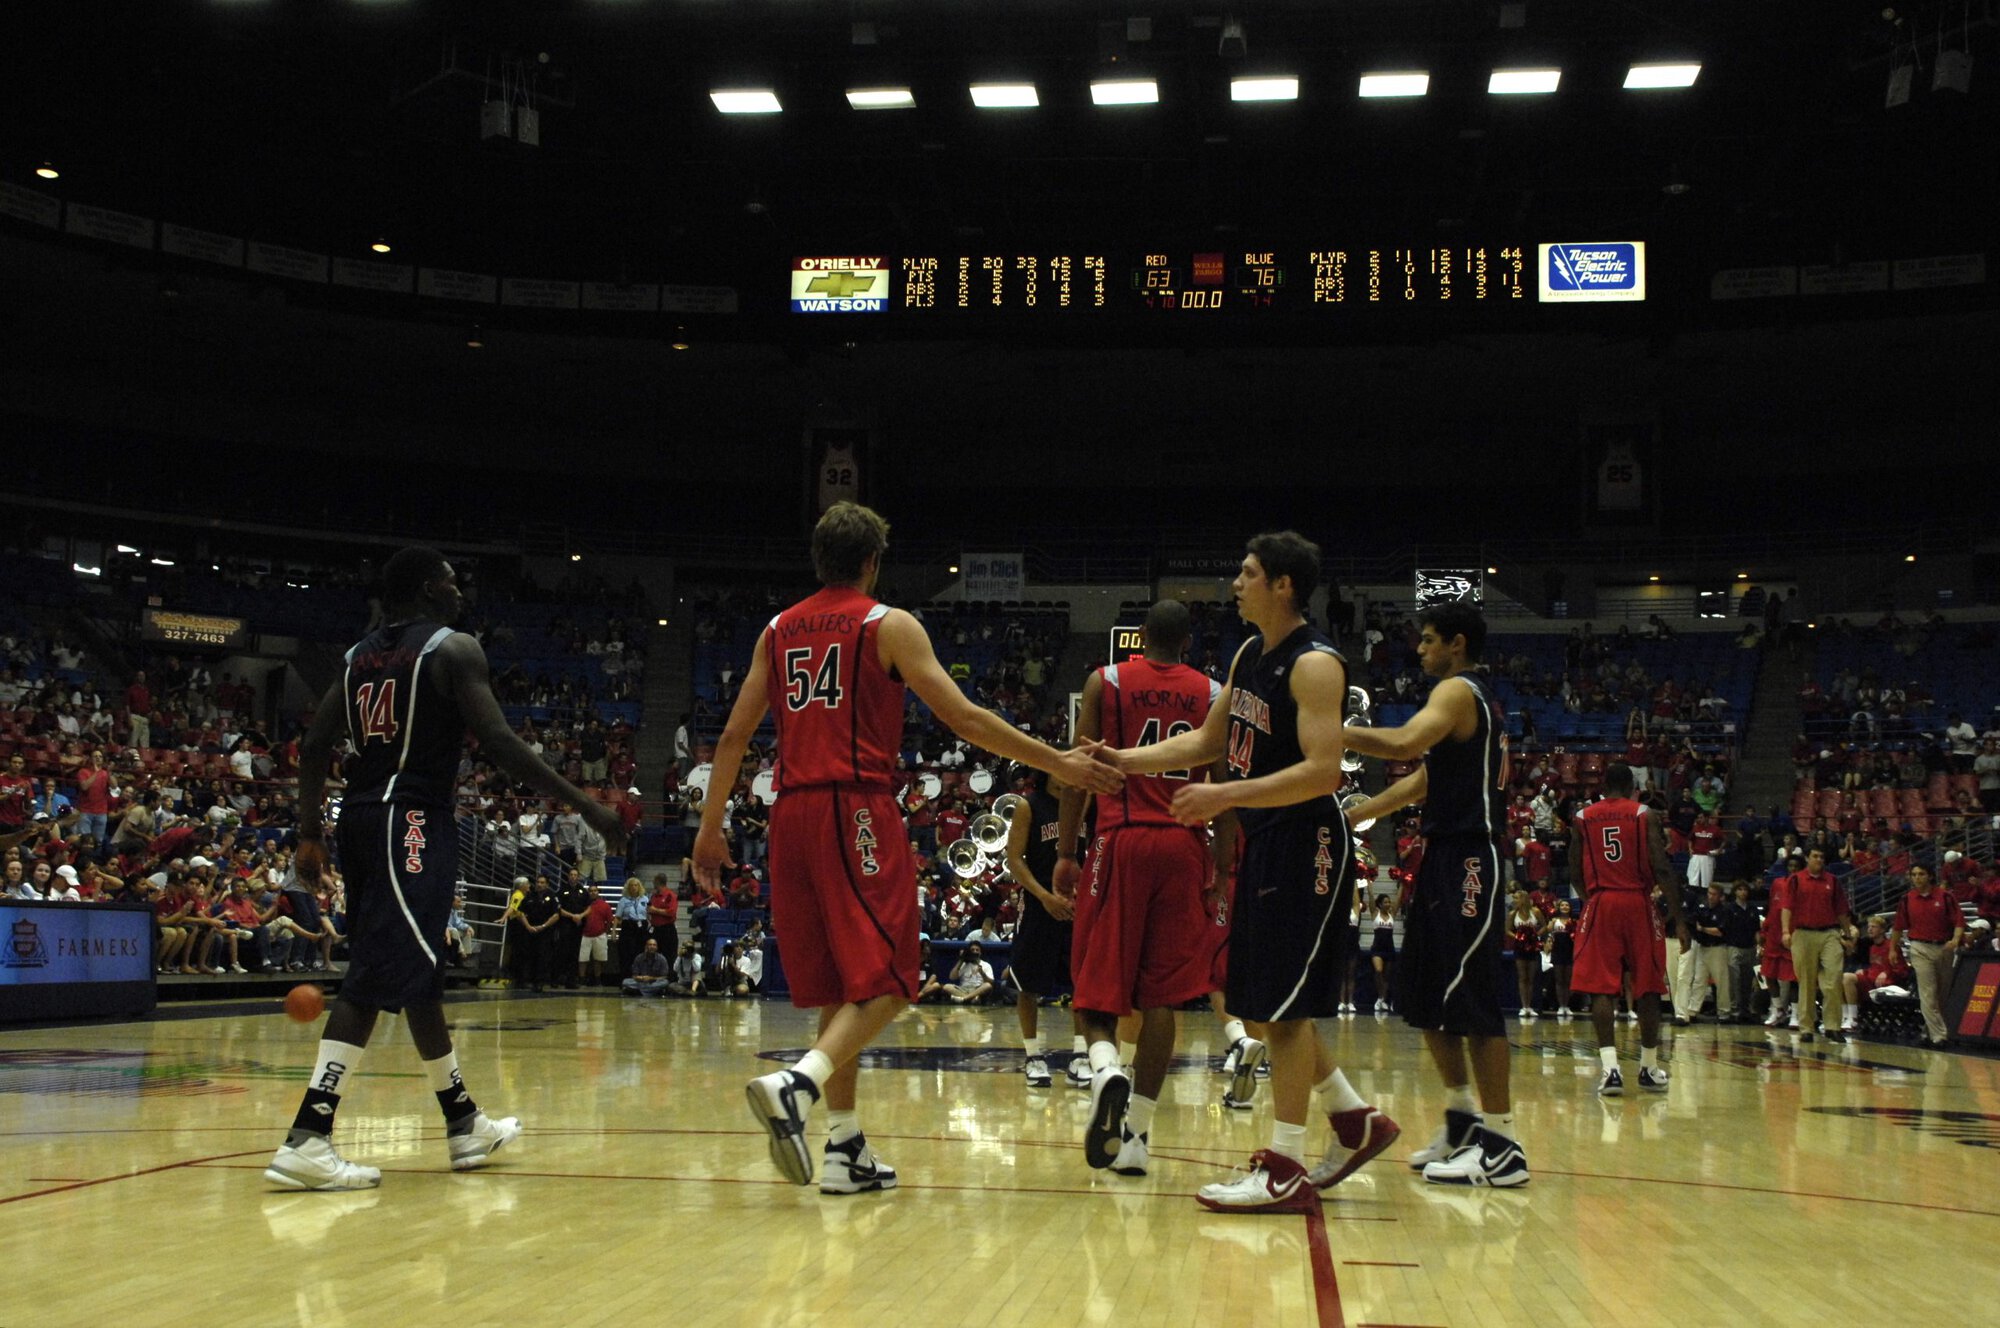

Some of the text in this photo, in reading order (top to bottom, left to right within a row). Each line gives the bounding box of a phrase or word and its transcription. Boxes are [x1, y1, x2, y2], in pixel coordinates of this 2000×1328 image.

[960, 257, 969, 269] 5
[983, 257, 1003, 269] 20
[1017, 257, 1037, 269] 33
[1051, 257, 1071, 269] 42
[1085, 257, 1105, 269] 54
[1146, 254, 1167, 266] RED
[1245, 253, 1274, 265] BLUE
[1310, 252, 1346, 264] PLYR
[1370, 250, 1380, 263] 2
[1432, 249, 1450, 261] 12
[1466, 248, 1486, 260] 14
[1500, 248, 1522, 260] 44
[1569, 249, 1617, 261] Tucson
[801, 258, 881, 270] O'RIELLY
[1316, 264, 1342, 277] PTS
[1405, 262, 1415, 274] 0
[1466, 260, 1486, 273] 13
[1512, 260, 1522, 272] 9
[1575, 260, 1627, 272] Electric
[908, 270, 933, 282] PTS
[993, 270, 1003, 281] 5
[1027, 270, 1037, 281] 0
[1053, 270, 1070, 281] 12
[1095, 270, 1105, 281] 5
[1147, 270, 1171, 288] 63
[1252, 268, 1275, 286] 76
[1314, 277, 1344, 290] RBS
[1370, 276, 1380, 288] 0
[1579, 272, 1628, 284] Power
[906, 282, 935, 294] RBS
[1026, 282, 1036, 294] 0
[1060, 282, 1070, 294] 4
[1095, 282, 1104, 294] 4
[1314, 290, 1344, 302] FLS
[1370, 288, 1380, 301] 2
[1405, 288, 1415, 300] 0
[1476, 286, 1486, 298] 3
[1512, 286, 1522, 298] 2
[800, 300, 880, 311] WATSON
[958, 294, 968, 306] 2
[992, 294, 1002, 306] 4
[1026, 294, 1036, 306] 0
[1060, 294, 1070, 306] 5
[1094, 294, 1104, 306] 3
[1182, 290, 1222, 308] 00.0
[826, 468, 852, 486] 32
[1607, 465, 1633, 482] 25
[1169, 560, 1193, 568] HALL
[1197, 560, 1208, 568] OF
[779, 614, 858, 639] WALTERS
[164, 630, 226, 644] 327-7463
[785, 643, 843, 712] 54
[1131, 690, 1198, 713] HORNE
[356, 678, 398, 746] 14
[1228, 720, 1254, 778] 44
[404, 810, 426, 873] CATS
[854, 808, 880, 875] CATS
[1602, 826, 1622, 862] 5
[1314, 826, 1332, 896] CATS
[1461, 856, 1482, 918] CATS
[58, 938, 138, 956] FARMERS
